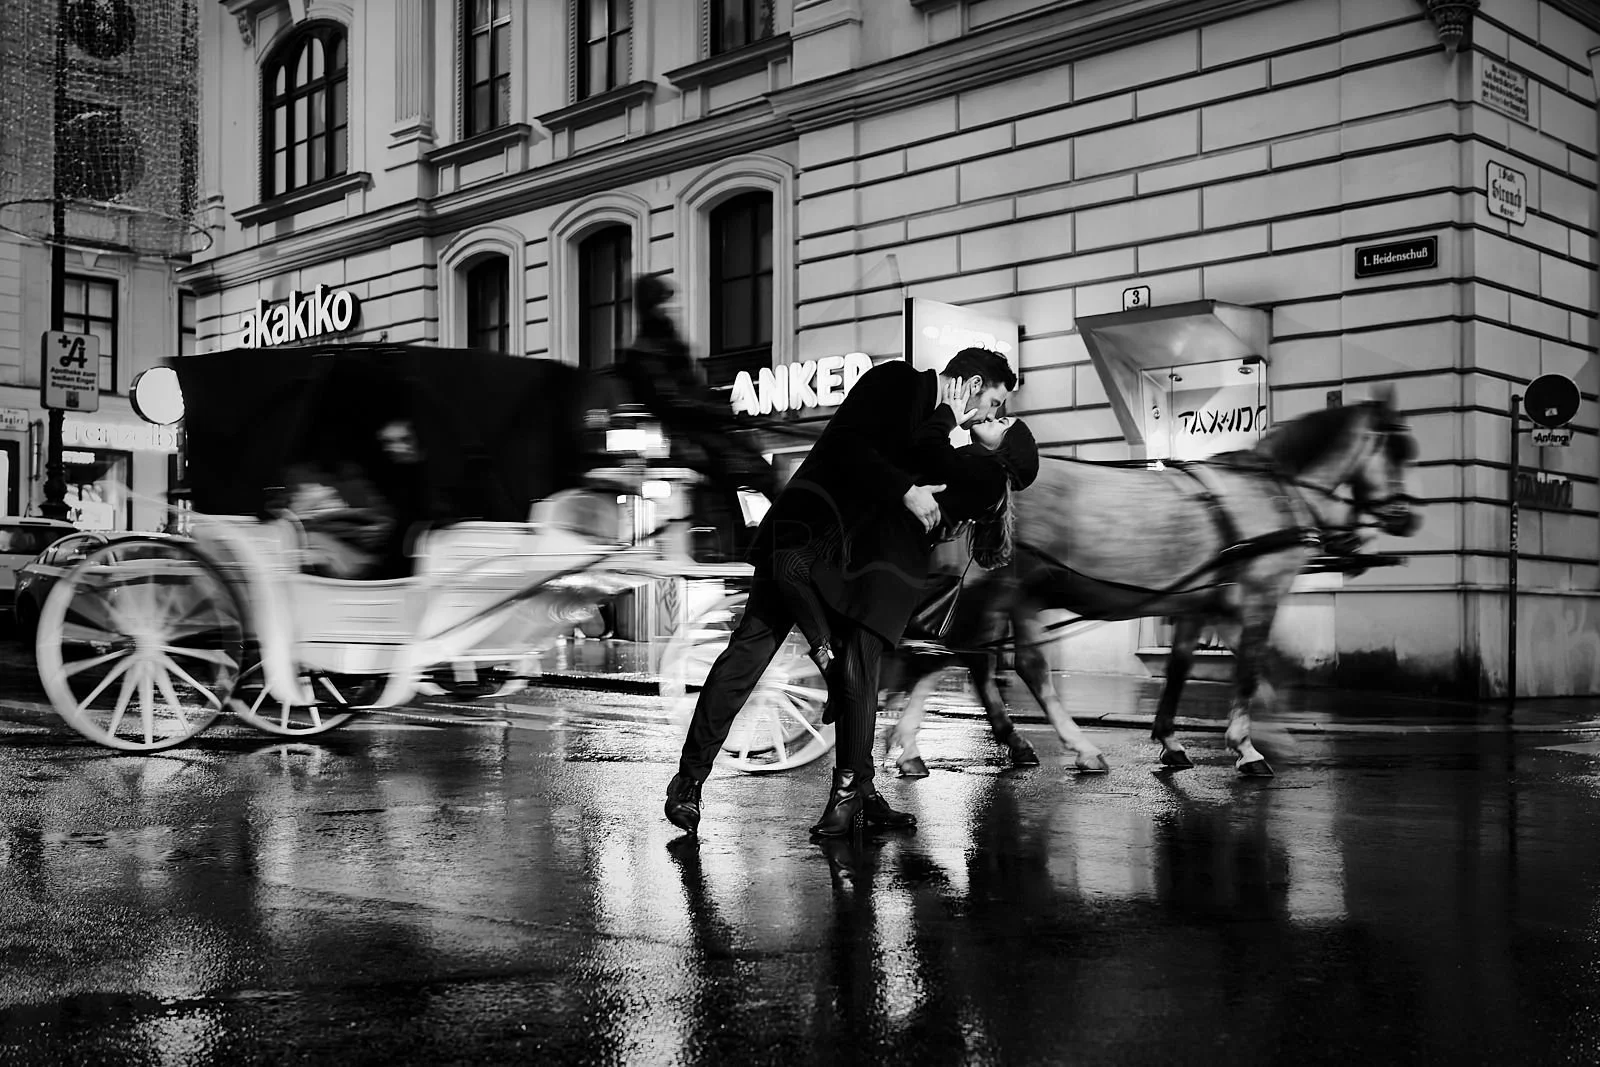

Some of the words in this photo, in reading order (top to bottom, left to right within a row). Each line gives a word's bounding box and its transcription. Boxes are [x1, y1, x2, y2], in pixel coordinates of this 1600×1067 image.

[1363, 256, 1371, 267] 1.
[1373, 247, 1428, 265] Heidenschuß
[1132, 289, 1140, 305] 3
[239, 284, 354, 350] akakiko
[50, 366, 81, 375] Apotheke
